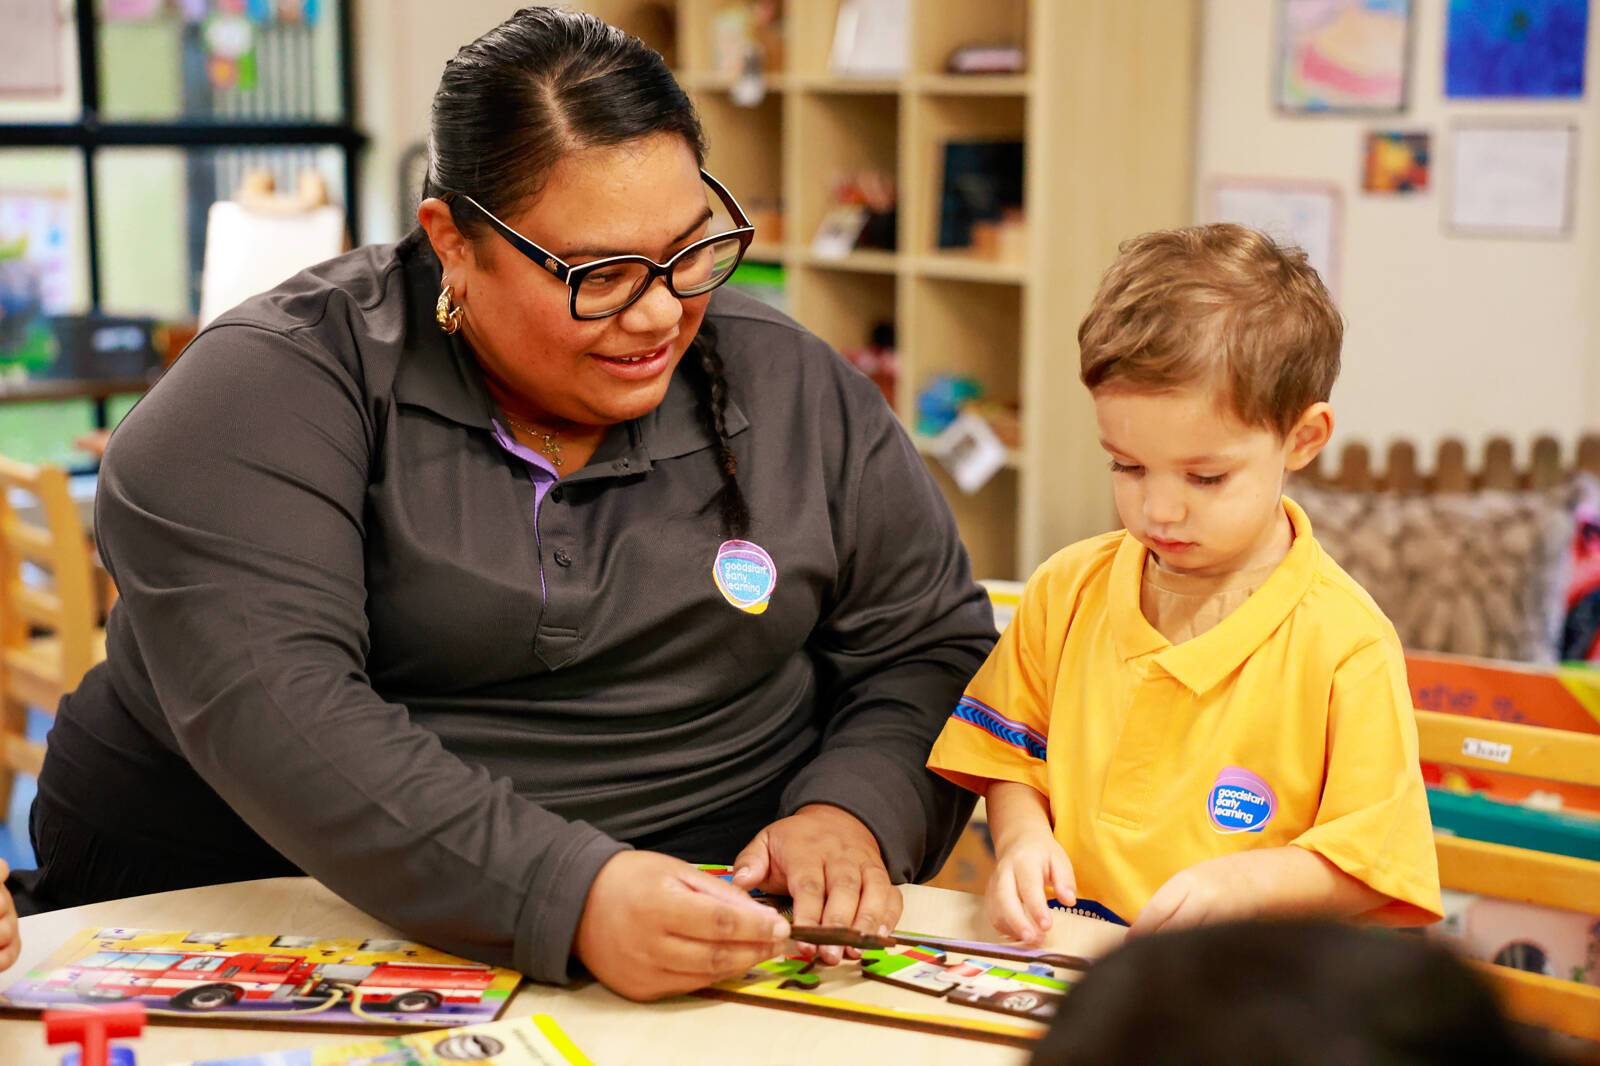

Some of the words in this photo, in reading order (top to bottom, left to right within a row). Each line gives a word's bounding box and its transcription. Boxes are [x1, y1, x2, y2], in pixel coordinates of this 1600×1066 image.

[724, 562, 768, 575] goodstart
[724, 571, 748, 581] early
[1215, 797, 1241, 810] early
[1218, 788, 1265, 806] goodstart
[1214, 805, 1254, 825] learning
